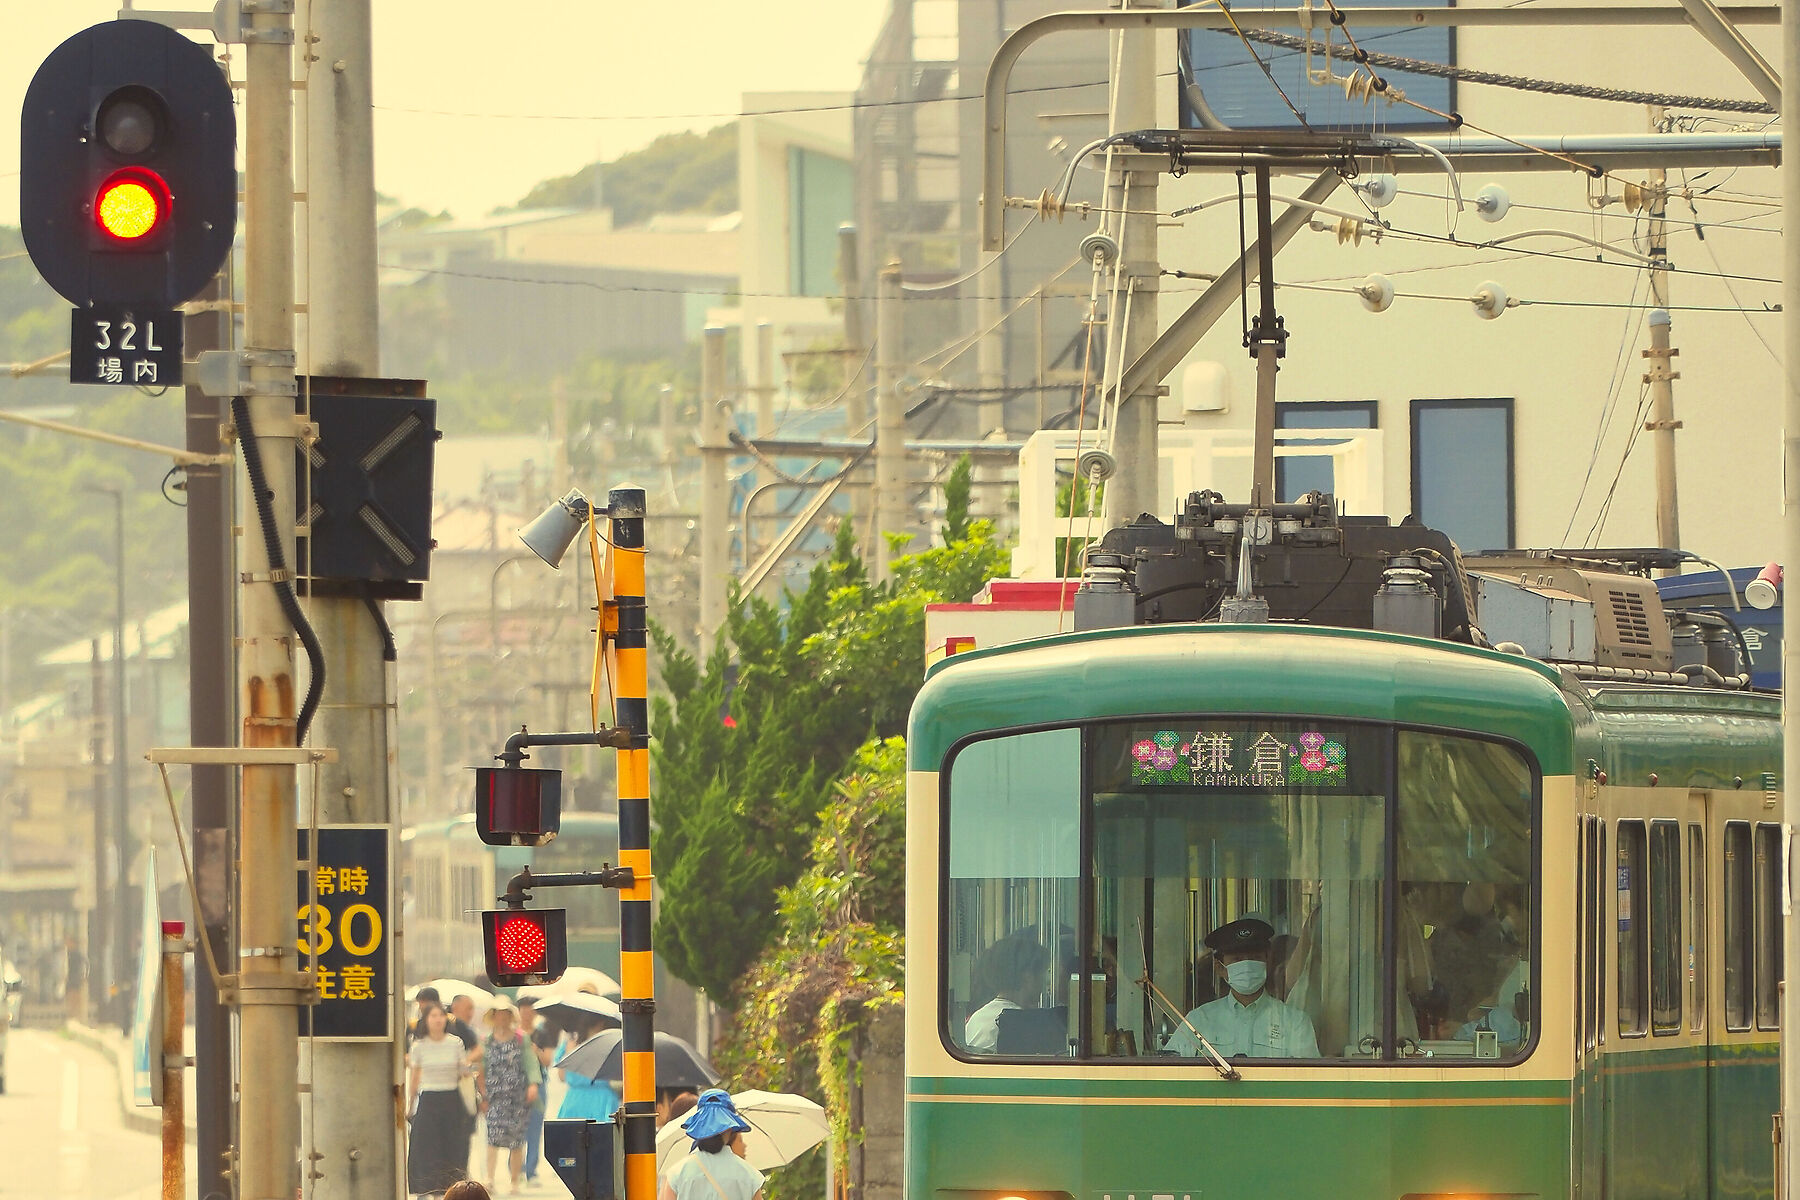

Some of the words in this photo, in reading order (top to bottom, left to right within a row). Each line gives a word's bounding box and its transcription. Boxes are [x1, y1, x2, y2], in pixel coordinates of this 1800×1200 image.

[95, 320, 163, 351] 32L
[98, 358, 158, 383] 場内
[1190, 728, 1289, 772] 鎌倉
[1192, 773, 1286, 787] KAMAKURA
[296, 903, 383, 957] 30
